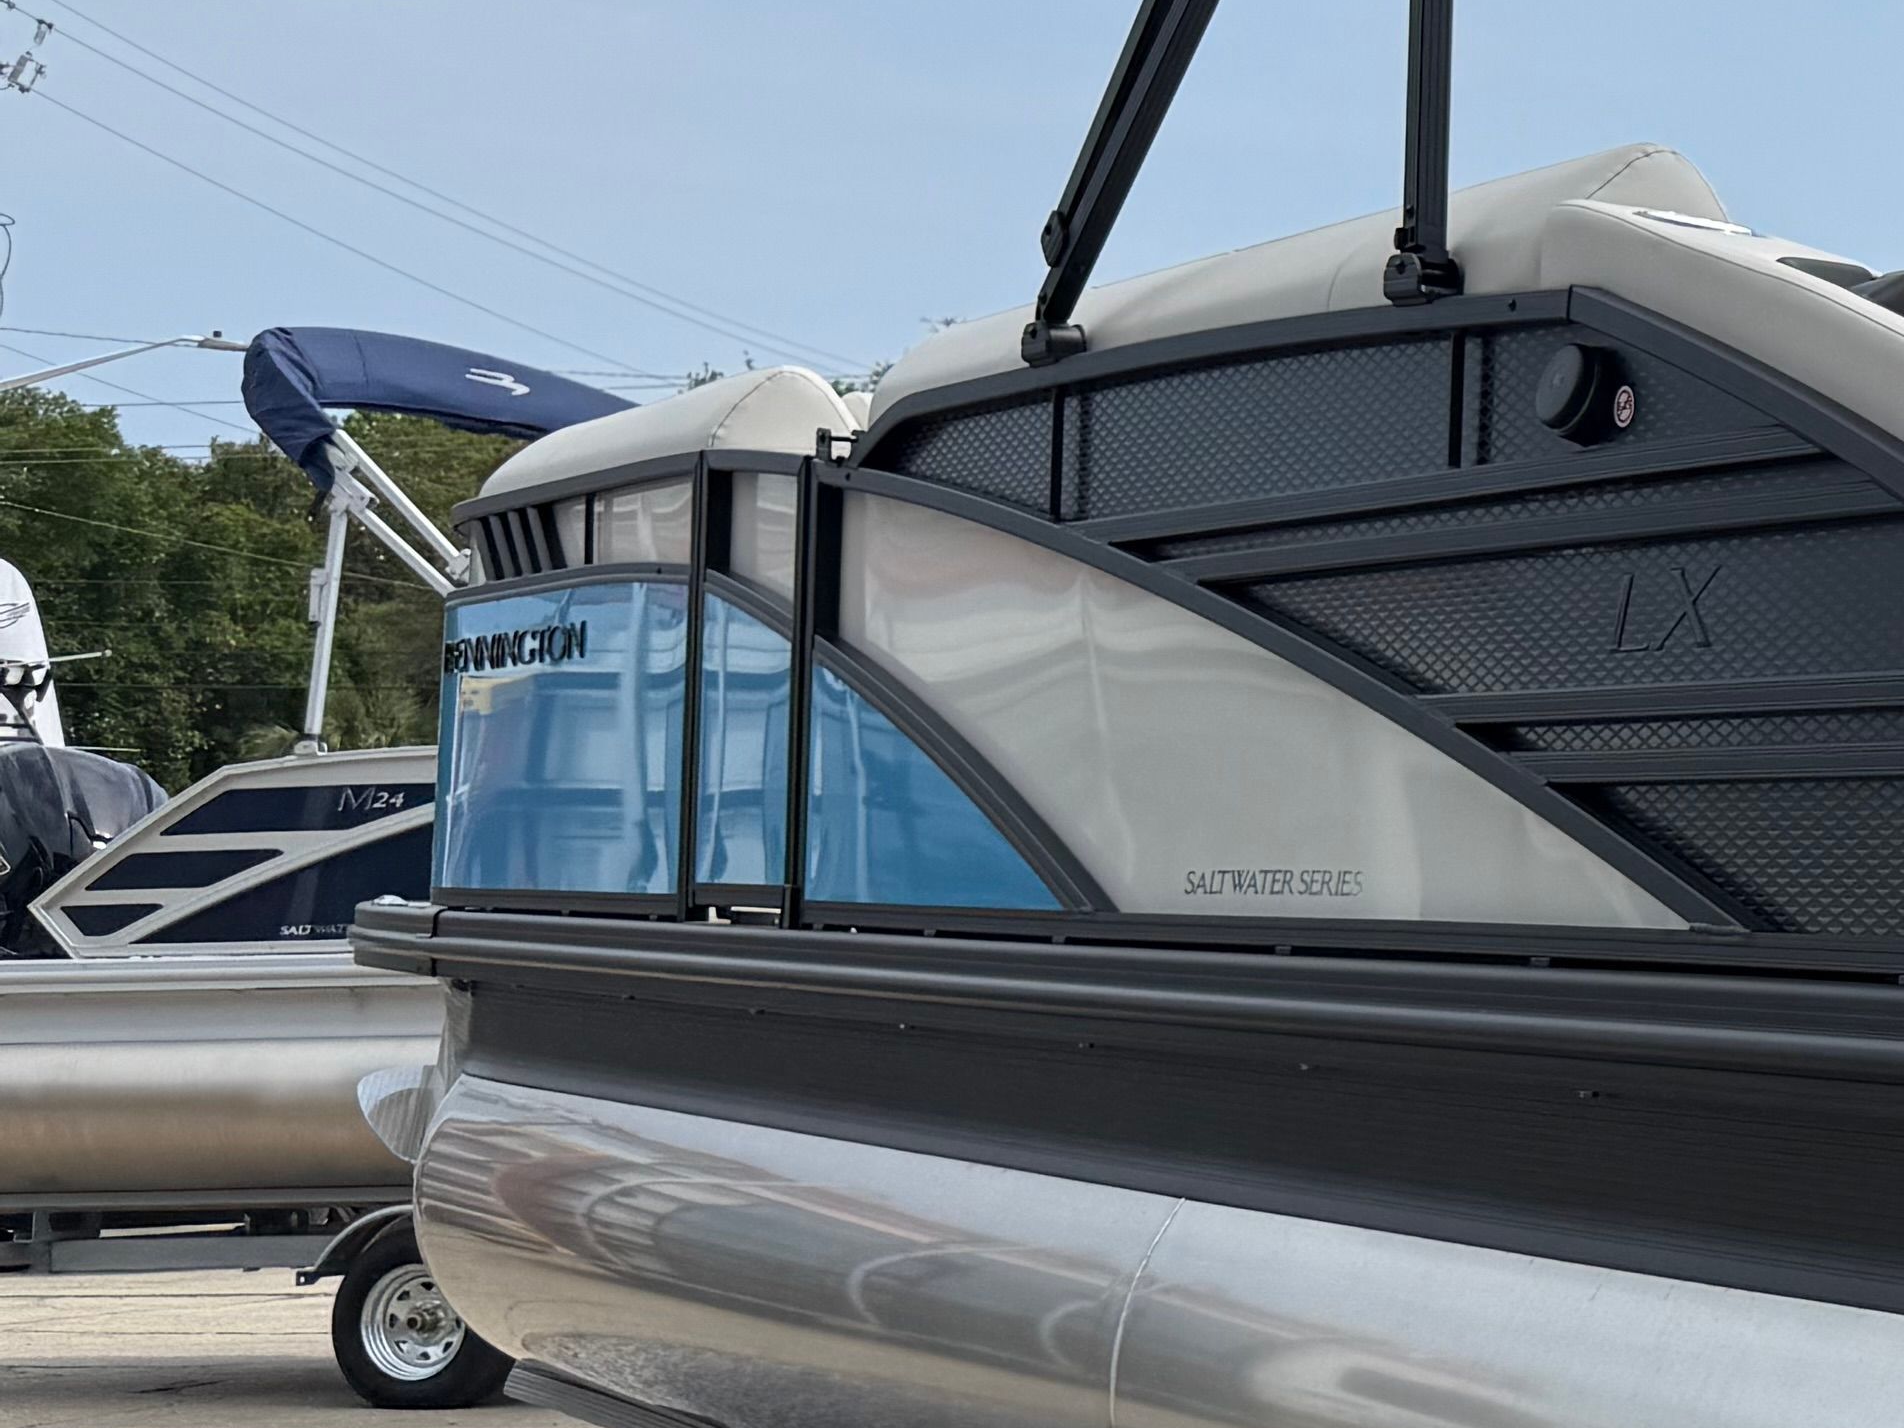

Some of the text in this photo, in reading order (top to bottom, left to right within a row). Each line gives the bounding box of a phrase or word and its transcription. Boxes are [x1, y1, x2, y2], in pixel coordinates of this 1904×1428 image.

[1609, 564, 1723, 654] LX
[1184, 869, 1364, 897] SALTWATER SERIES
